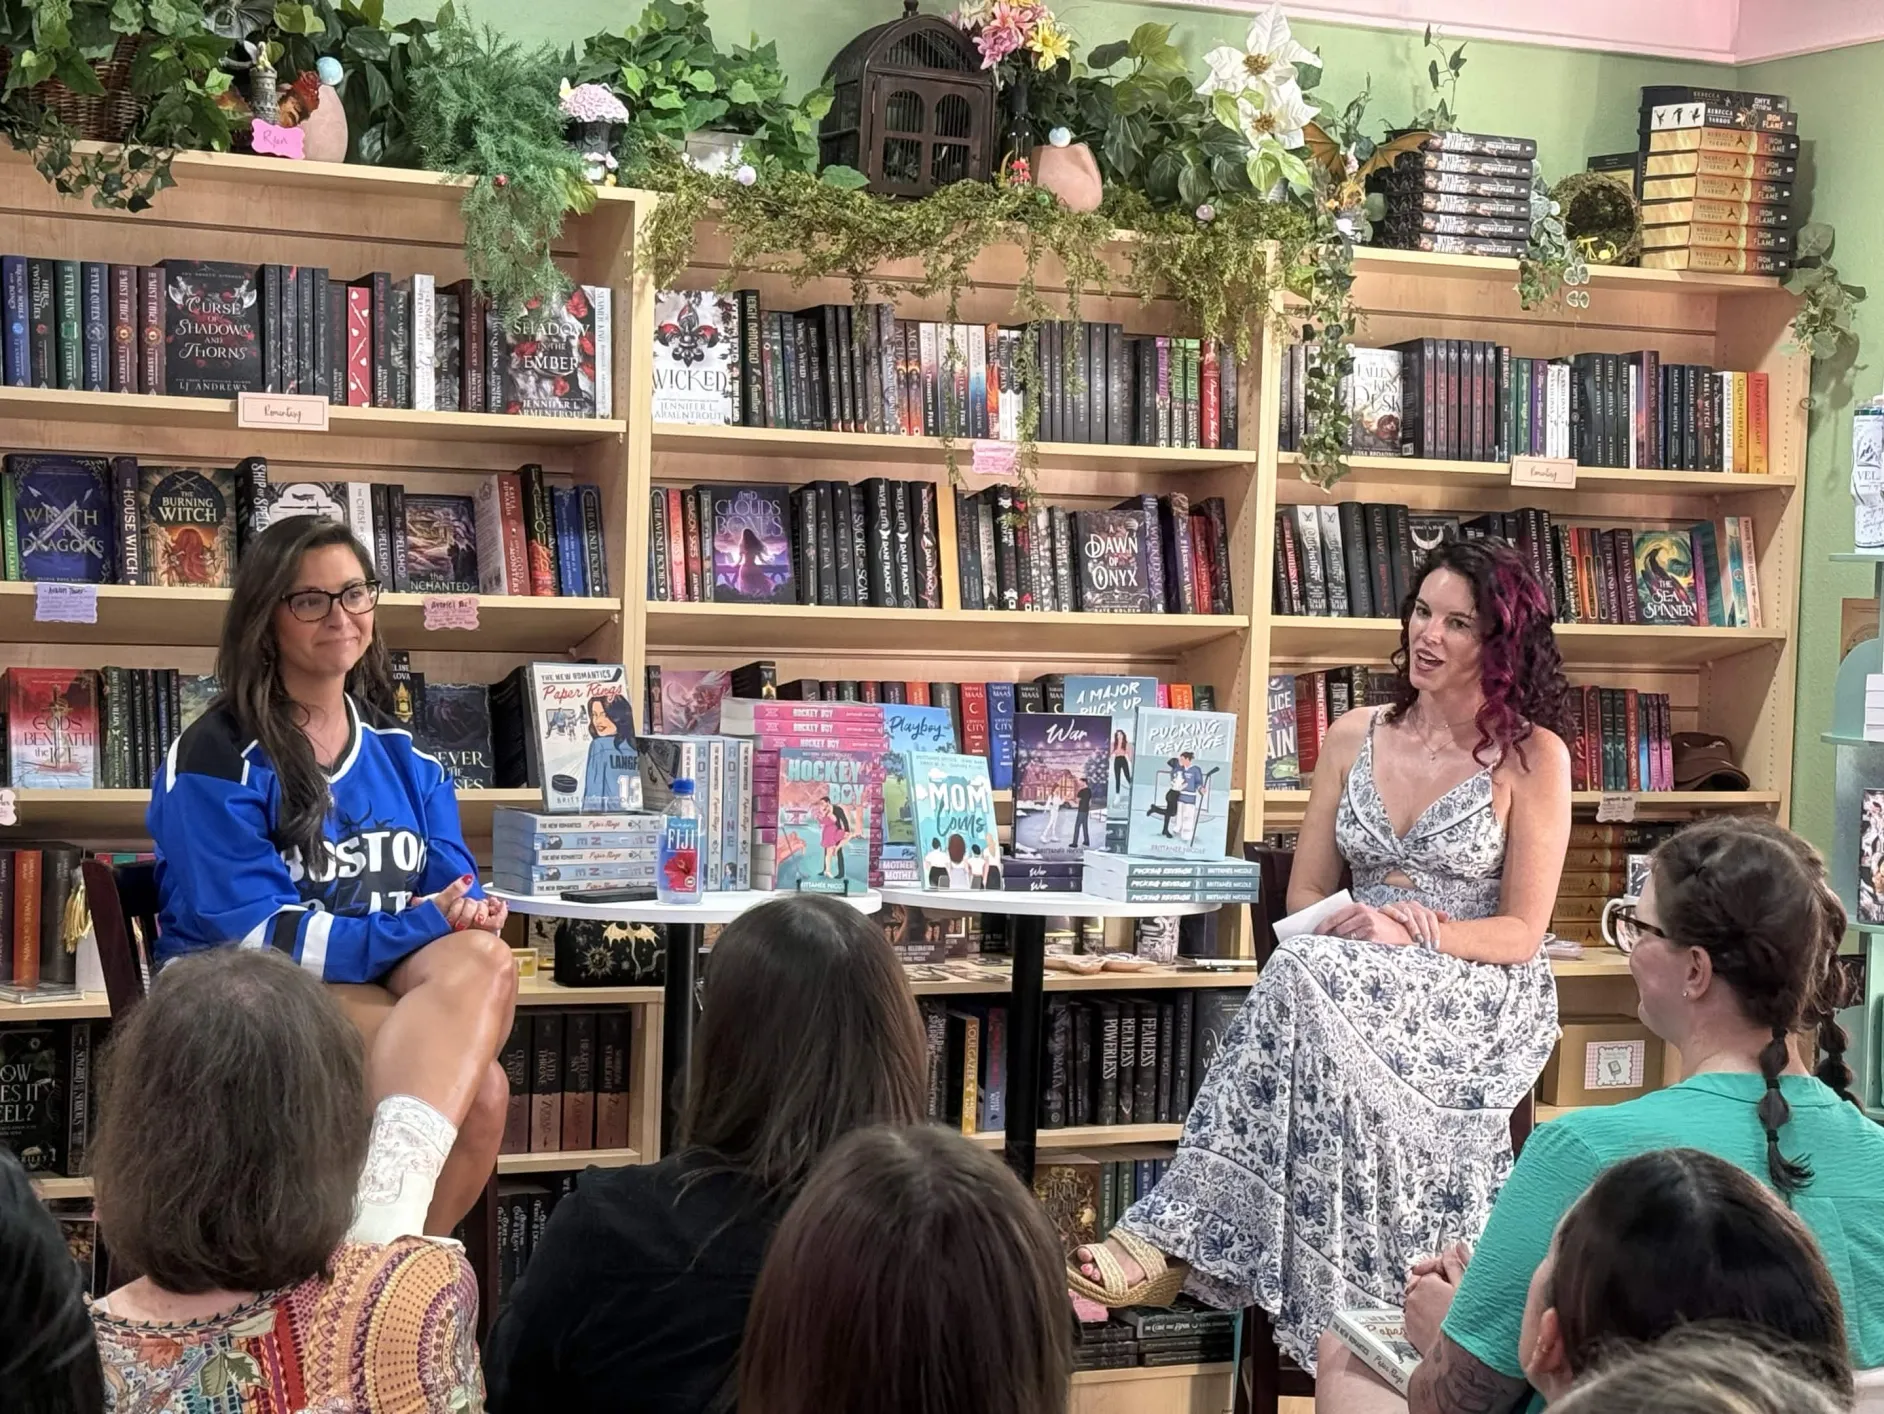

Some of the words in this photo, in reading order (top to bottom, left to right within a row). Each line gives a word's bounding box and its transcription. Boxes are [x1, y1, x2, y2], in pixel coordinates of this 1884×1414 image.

[1707, 108, 1733, 116] REBECCA
[1762, 120, 1783, 129] FLAME
[1758, 191, 1778, 200] FLAME
[1756, 215, 1776, 224] FLAME
[1754, 238, 1775, 246] FLAME
[1753, 262, 1774, 270] FLAME
[65, 298, 75, 318] KING
[90, 295, 101, 320] QUEEN
[186, 296, 241, 315] CURSE
[747, 296, 758, 319] LEIGH
[175, 318, 251, 336] SHADOWS
[513, 321, 589, 337] SHADOW
[204, 336, 222, 344] AND
[748, 323, 759, 364] BARDUGO
[178, 342, 248, 360] THORNS
[525, 354, 578, 370] EMBER
[180, 383, 190, 391] LJ
[195, 382, 248, 391] ANDREWS
[653, 368, 727, 392] WICKED
[522, 400, 567, 409] JENNIFER
[660, 402, 706, 410] JENNIFER
[654, 412, 723, 420] ARMENTROUT
[251, 463, 266, 487] SHIP
[162, 498, 214, 508] BURNING
[715, 500, 781, 515] CLOUDS
[896, 487, 904, 510] SILVER
[122, 490, 136, 527] HOUSE
[158, 506, 218, 522] WITCH
[586, 508, 597, 550] HEAVENLY
[654, 509, 664, 551] HEAVENLY
[715, 515, 783, 538] BONES
[853, 514, 865, 556] SMOKE
[1542, 513, 1550, 542] BLOOD
[124, 530, 138, 576] WITCH
[378, 528, 388, 576] SPELLSHOP
[395, 530, 406, 578] SPELLSHOP
[882, 541, 890, 560] DANI
[899, 544, 907, 562] DANI
[1085, 533, 1138, 558] DAWN
[1108, 556, 1120, 566] OF
[1545, 544, 1553, 573] BOUND
[430, 572, 443, 580] the
[656, 555, 666, 586] BODIES
[1092, 566, 1138, 590] ONYX
[1623, 559, 1631, 582] WIND
[410, 581, 469, 591] NCHANTED
[857, 569, 868, 601] SCAR
[1291, 579, 1299, 597] ONE
[1659, 580, 1673, 588] THE
[1626, 585, 1635, 621] WEAVER
[1652, 589, 1679, 604] SEA
[1643, 602, 1696, 618] SPINNER
[556, 672, 571, 680] NEW
[573, 670, 611, 678] ROMANTICS
[543, 684, 582, 704] Paper
[587, 681, 622, 702] Rings
[1076, 691, 1084, 704] A
[1086, 682, 1140, 700] MAJOR
[792, 708, 818, 718] HOCKEY
[821, 709, 833, 718] BOY
[1122, 697, 1142, 710] UP
[32, 715, 83, 730] GODS
[793, 723, 819, 732] HOCKEY
[821, 724, 833, 733] BOY
[890, 716, 947, 740] Playboy
[967, 724, 984, 732] CITY
[995, 723, 1012, 731] CITY
[1046, 719, 1088, 744] War
[1150, 720, 1219, 740] PUCKING
[800, 739, 825, 748] HOCKEY
[827, 740, 840, 748] BOY
[1154, 736, 1226, 755] REVENGE
[434, 751, 491, 768] EVER
[788, 759, 862, 783] HOCKEY
[829, 783, 864, 805] BOY
[929, 783, 988, 813] MOM
[667, 829, 694, 850] FIJI
[1103, 1019, 1118, 1079] POWERLESS
[1121, 1018, 1135, 1067] RECKLESS
[1140, 1018, 1157, 1067] FEARLESS
[967, 1025, 976, 1080] SOULGAZER
[0, 1064, 32, 1082] OW
[27, 1083, 42, 1101] IT
[0, 1104, 35, 1123] EEL?
